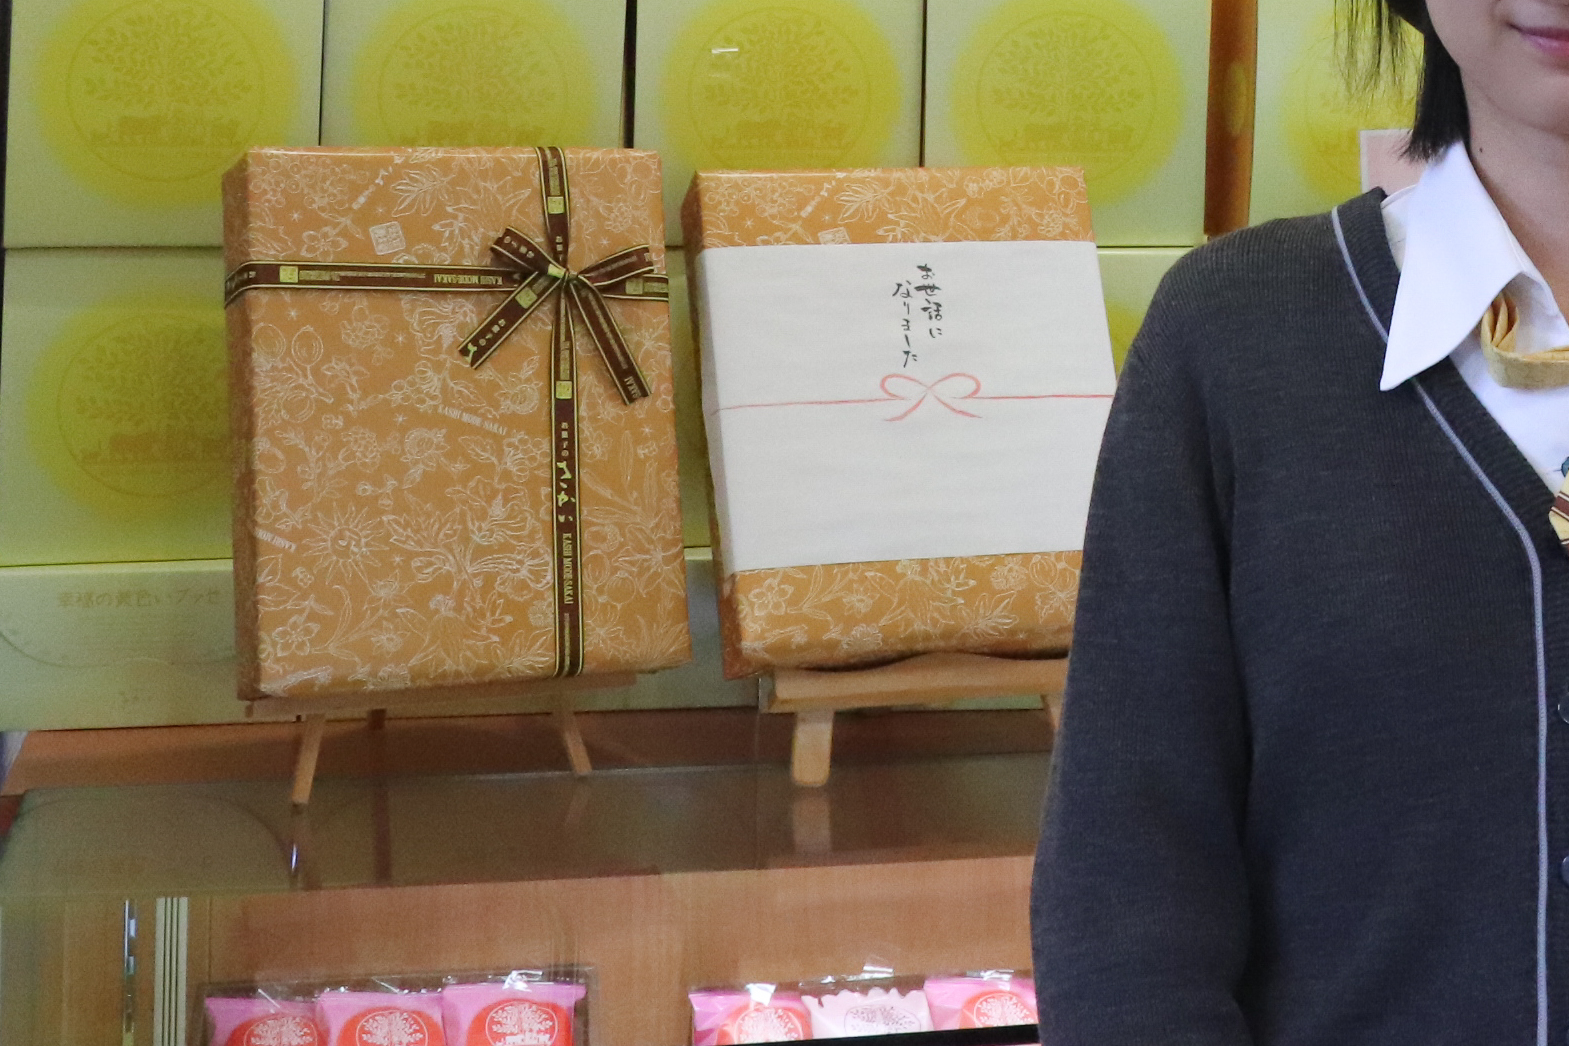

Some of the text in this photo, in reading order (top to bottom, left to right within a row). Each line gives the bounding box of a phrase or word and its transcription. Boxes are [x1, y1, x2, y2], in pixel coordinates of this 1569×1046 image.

[892, 280, 918, 368] なりました
